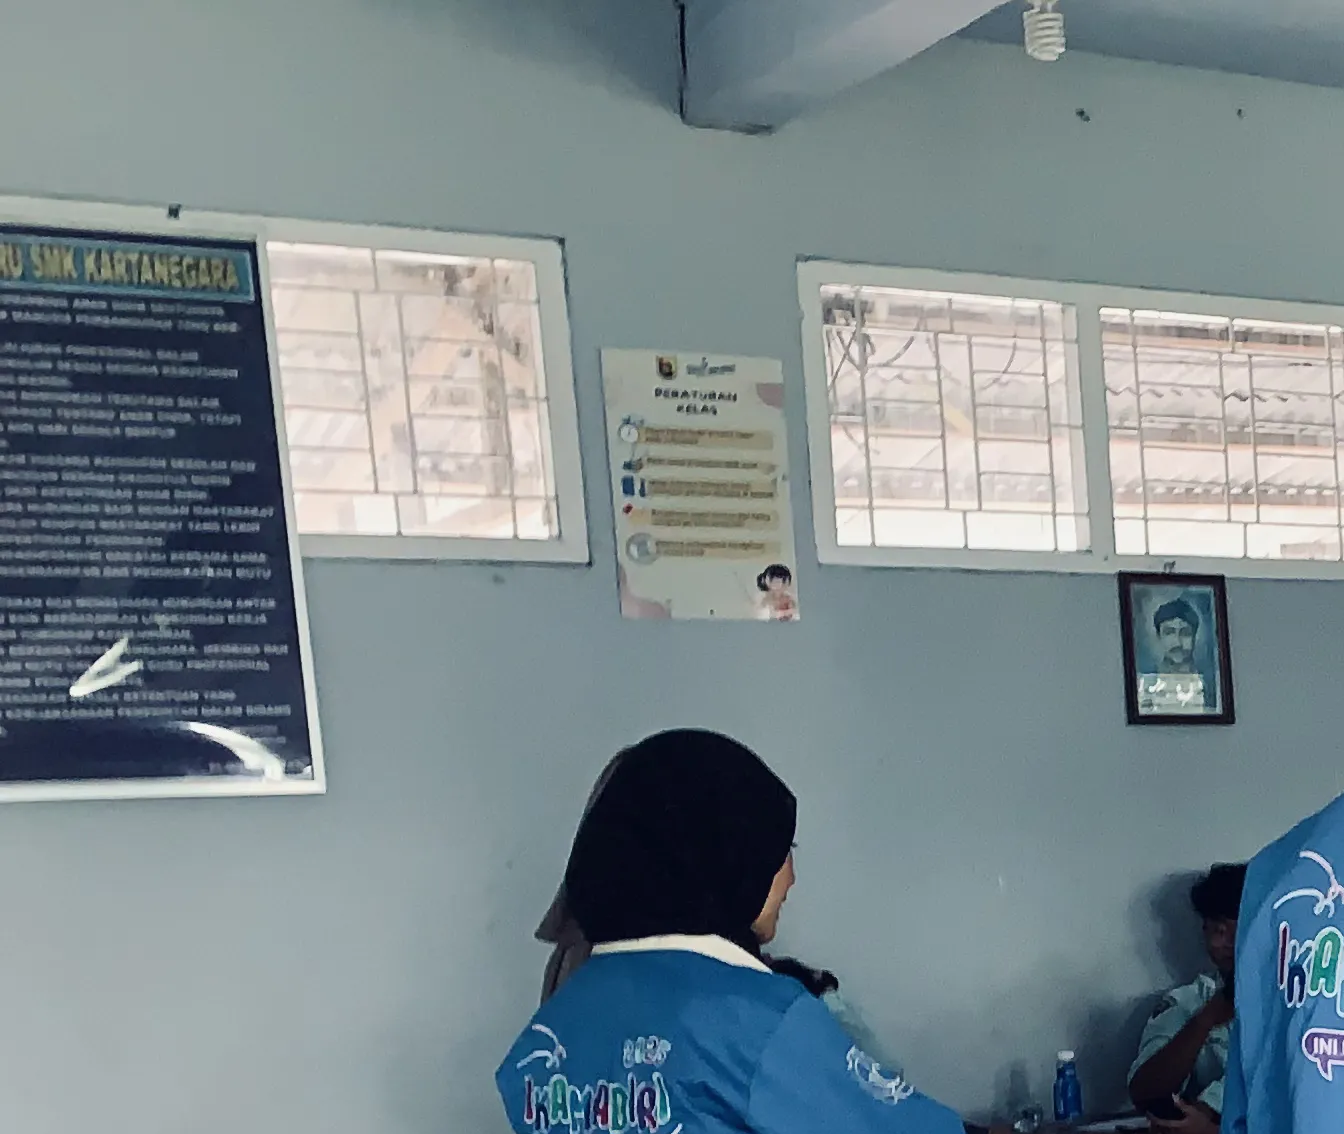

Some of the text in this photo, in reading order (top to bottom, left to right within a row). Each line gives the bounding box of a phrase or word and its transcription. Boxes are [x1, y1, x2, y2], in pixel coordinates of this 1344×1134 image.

[31, 243, 78, 279] SMK
[84, 248, 240, 291] KARTANEGARA
[1313, 1036, 1338, 1057] INI
